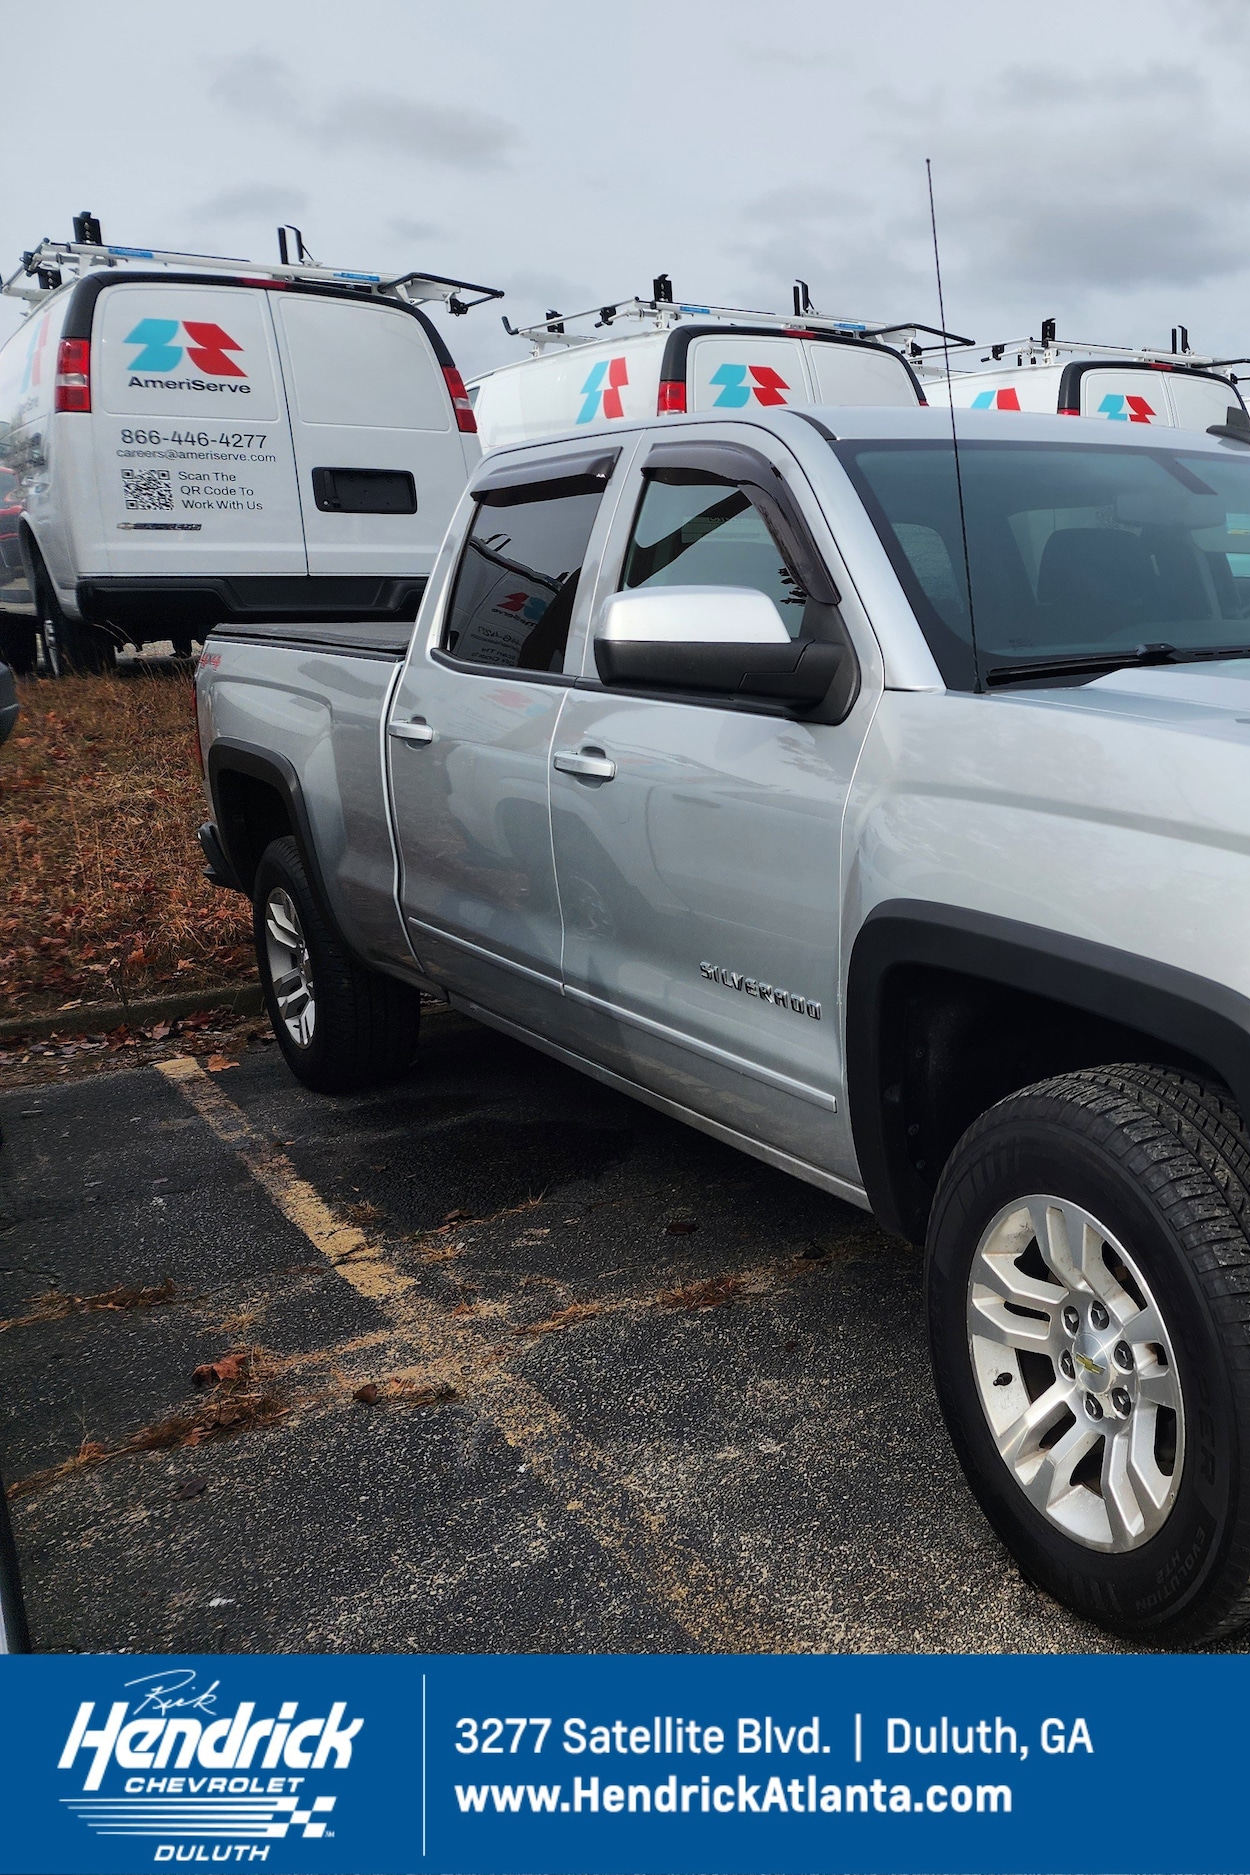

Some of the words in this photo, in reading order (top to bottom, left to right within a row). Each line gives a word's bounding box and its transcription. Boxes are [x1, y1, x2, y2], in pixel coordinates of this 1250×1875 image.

[127, 376, 252, 394] AmeriServe
[120, 428, 268, 449] 866-446-4277
[116, 449, 276, 462] careers@ameriserve.com
[178, 471, 210, 481] Scan
[213, 472, 237, 482] The
[180, 486, 201, 497] QR
[204, 486, 237, 496] Code
[239, 486, 254, 496] To
[182, 500, 214, 510] Work
[217, 500, 244, 510] With
[247, 501, 263, 510] Us
[700, 961, 822, 1020] SILVERADO
